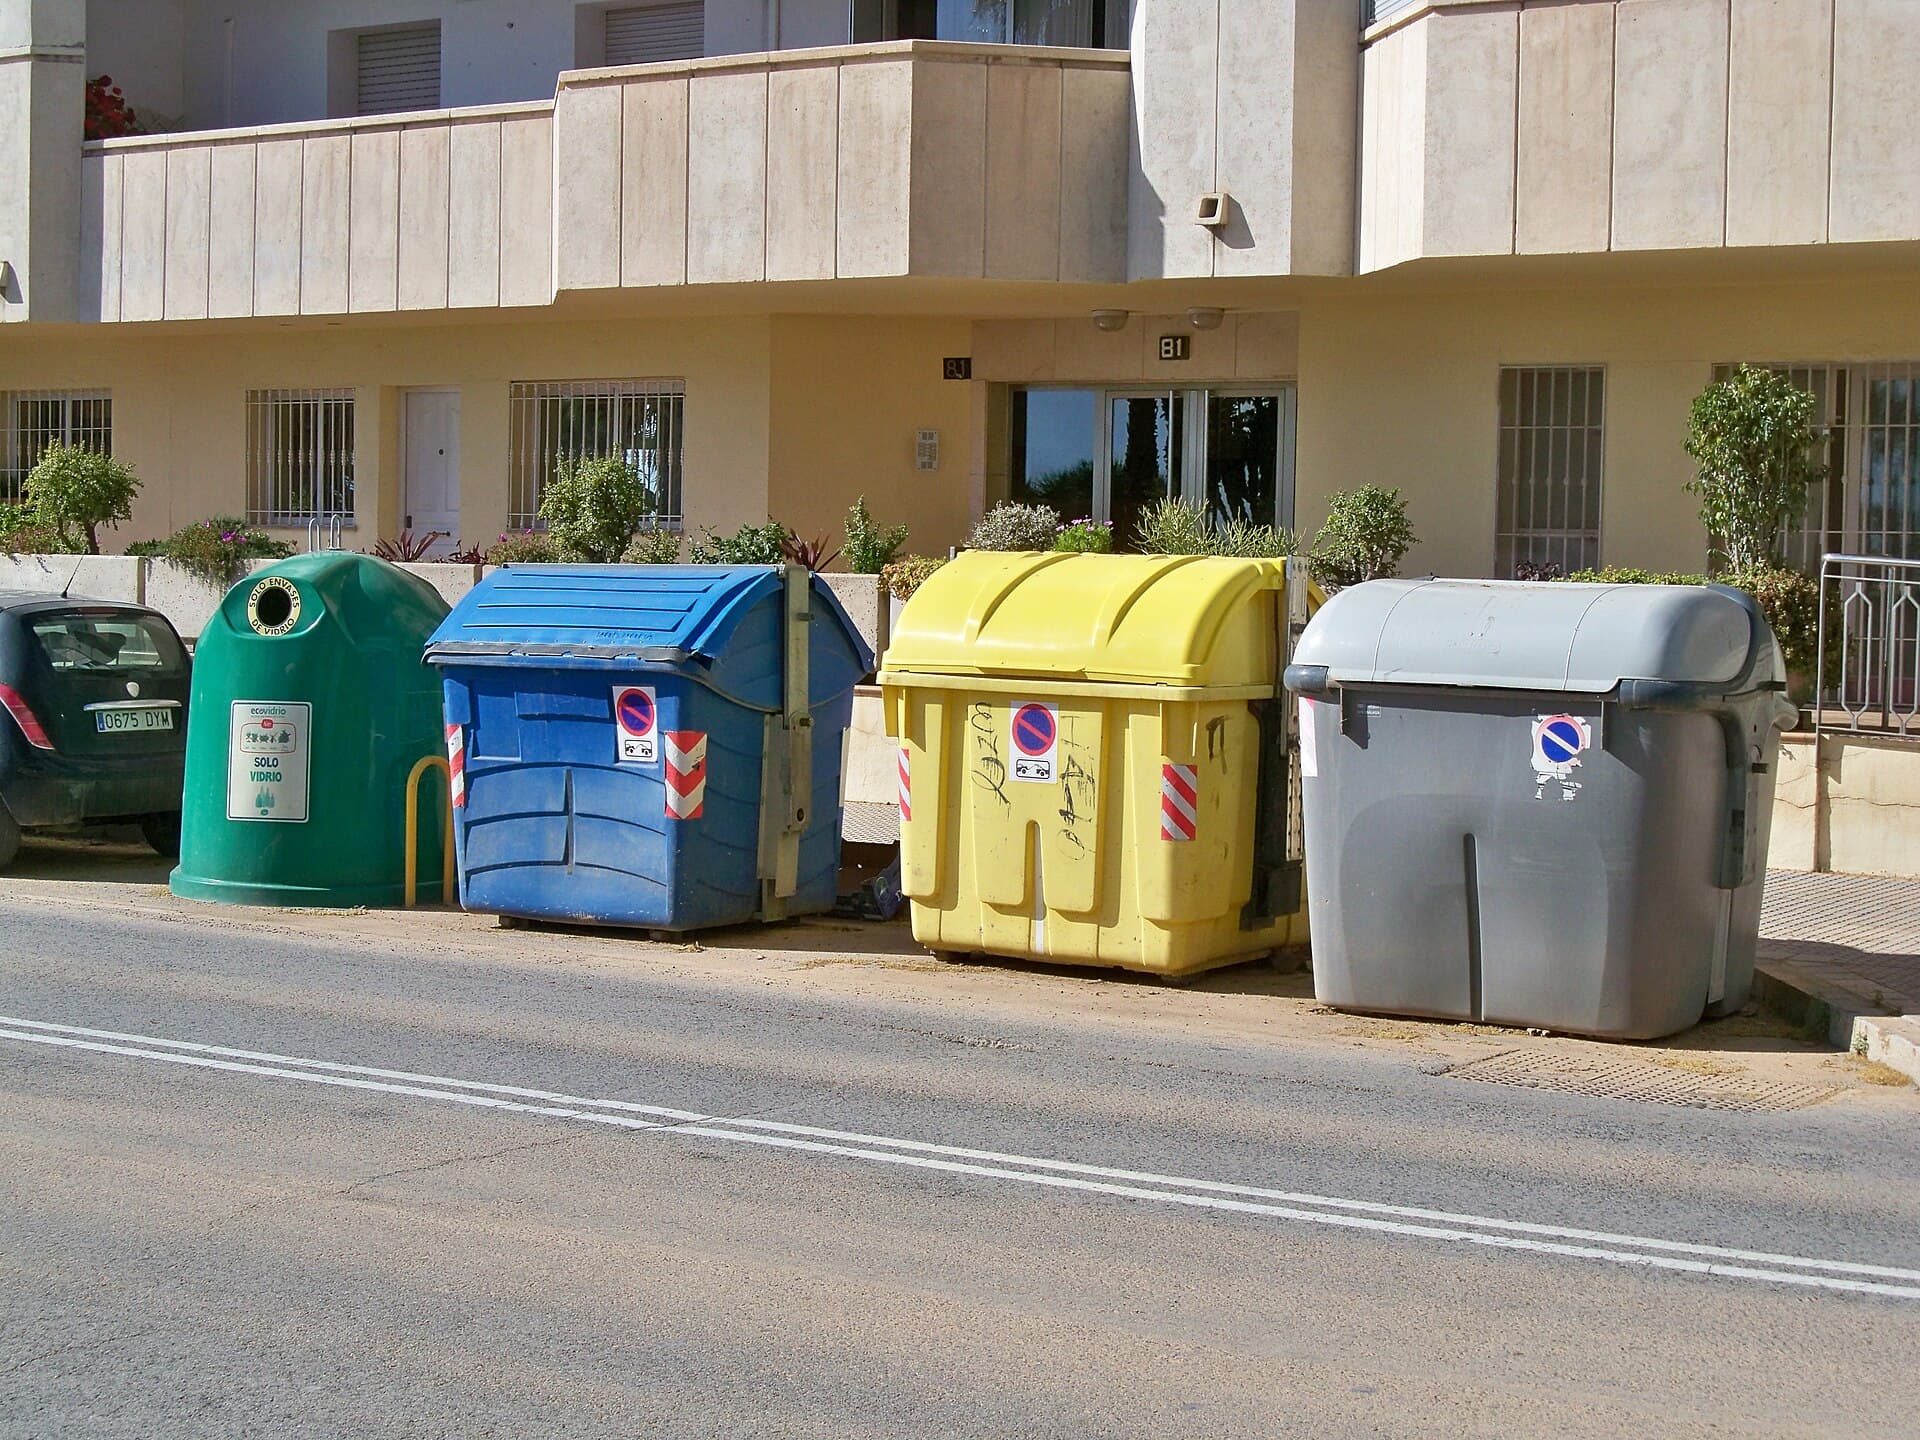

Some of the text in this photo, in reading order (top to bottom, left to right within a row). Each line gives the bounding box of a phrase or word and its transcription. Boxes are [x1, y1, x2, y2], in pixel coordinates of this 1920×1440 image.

[1160, 337, 1182, 358] 81
[946, 359, 965, 378] 81
[249, 578, 300, 608] SOLO ENVASES
[251, 618, 295, 635] DE VIDRIO
[250, 706, 287, 715] ecovidrio
[105, 711, 170, 729] 0675 DYM
[254, 757, 279, 768] SOLO
[250, 771, 282, 782] VIDRIO
